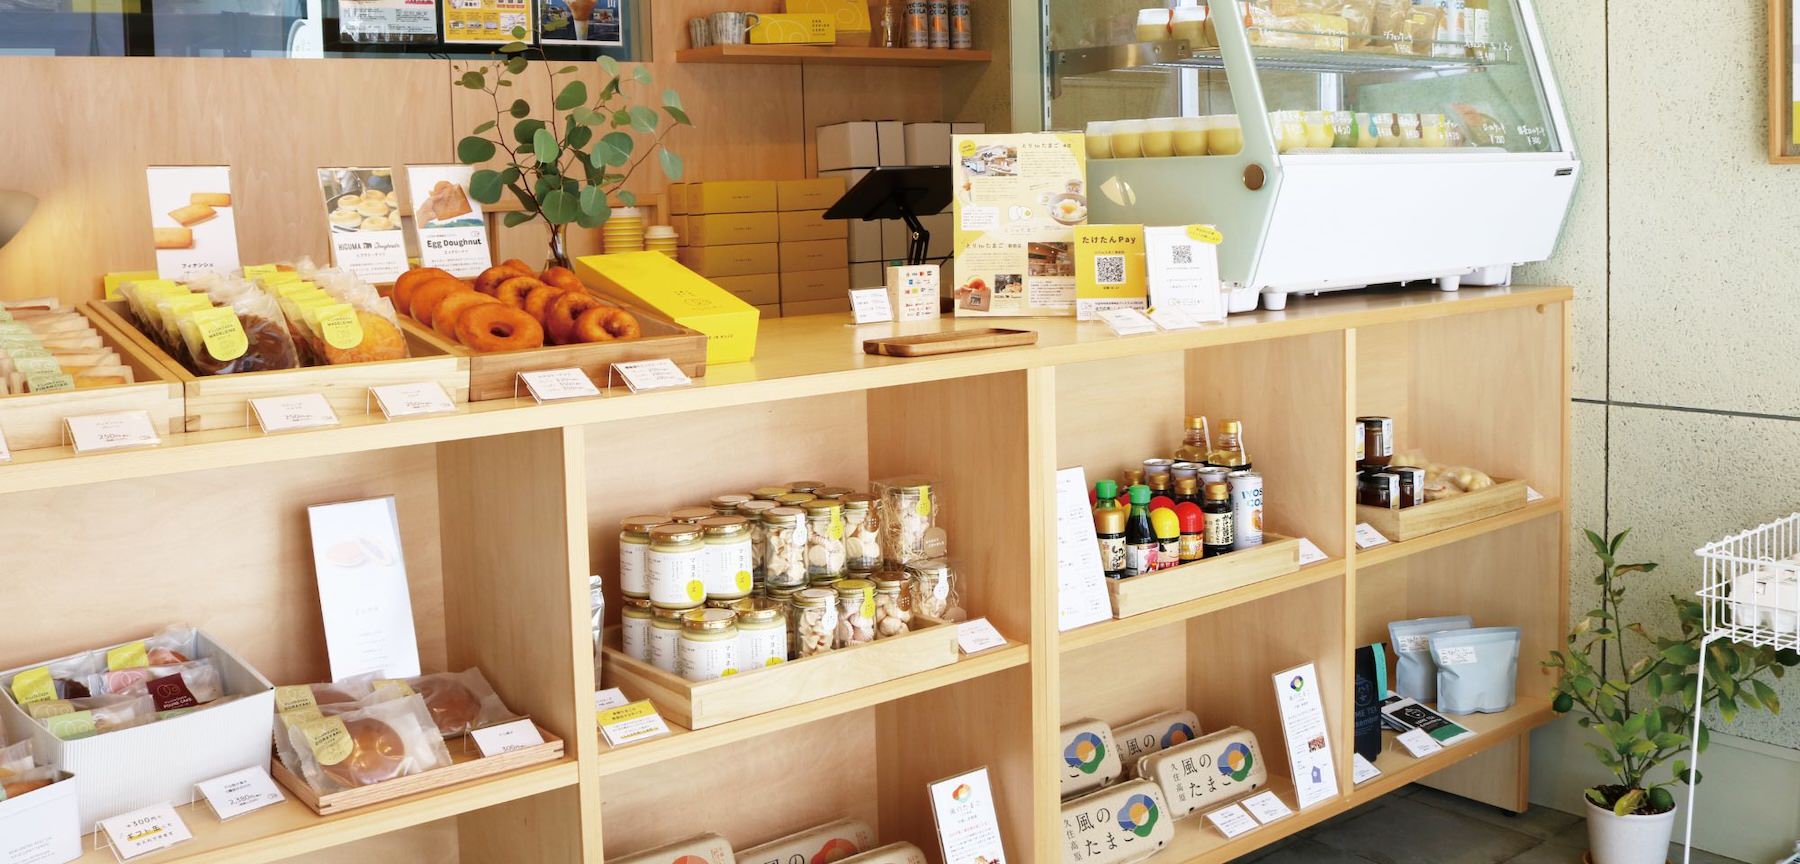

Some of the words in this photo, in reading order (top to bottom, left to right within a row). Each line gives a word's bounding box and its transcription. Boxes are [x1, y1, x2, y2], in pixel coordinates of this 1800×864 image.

[427, 240, 442, 249] Egg
[443, 238, 482, 247] Doughnut
[1082, 236, 1136, 244] たけたんPay
[1126, 734, 1156, 757] 風の
[1181, 753, 1212, 777] 風の
[1188, 772, 1232, 799] たまご
[1075, 807, 1111, 834] 風の
[1085, 828, 1135, 857] たまご
